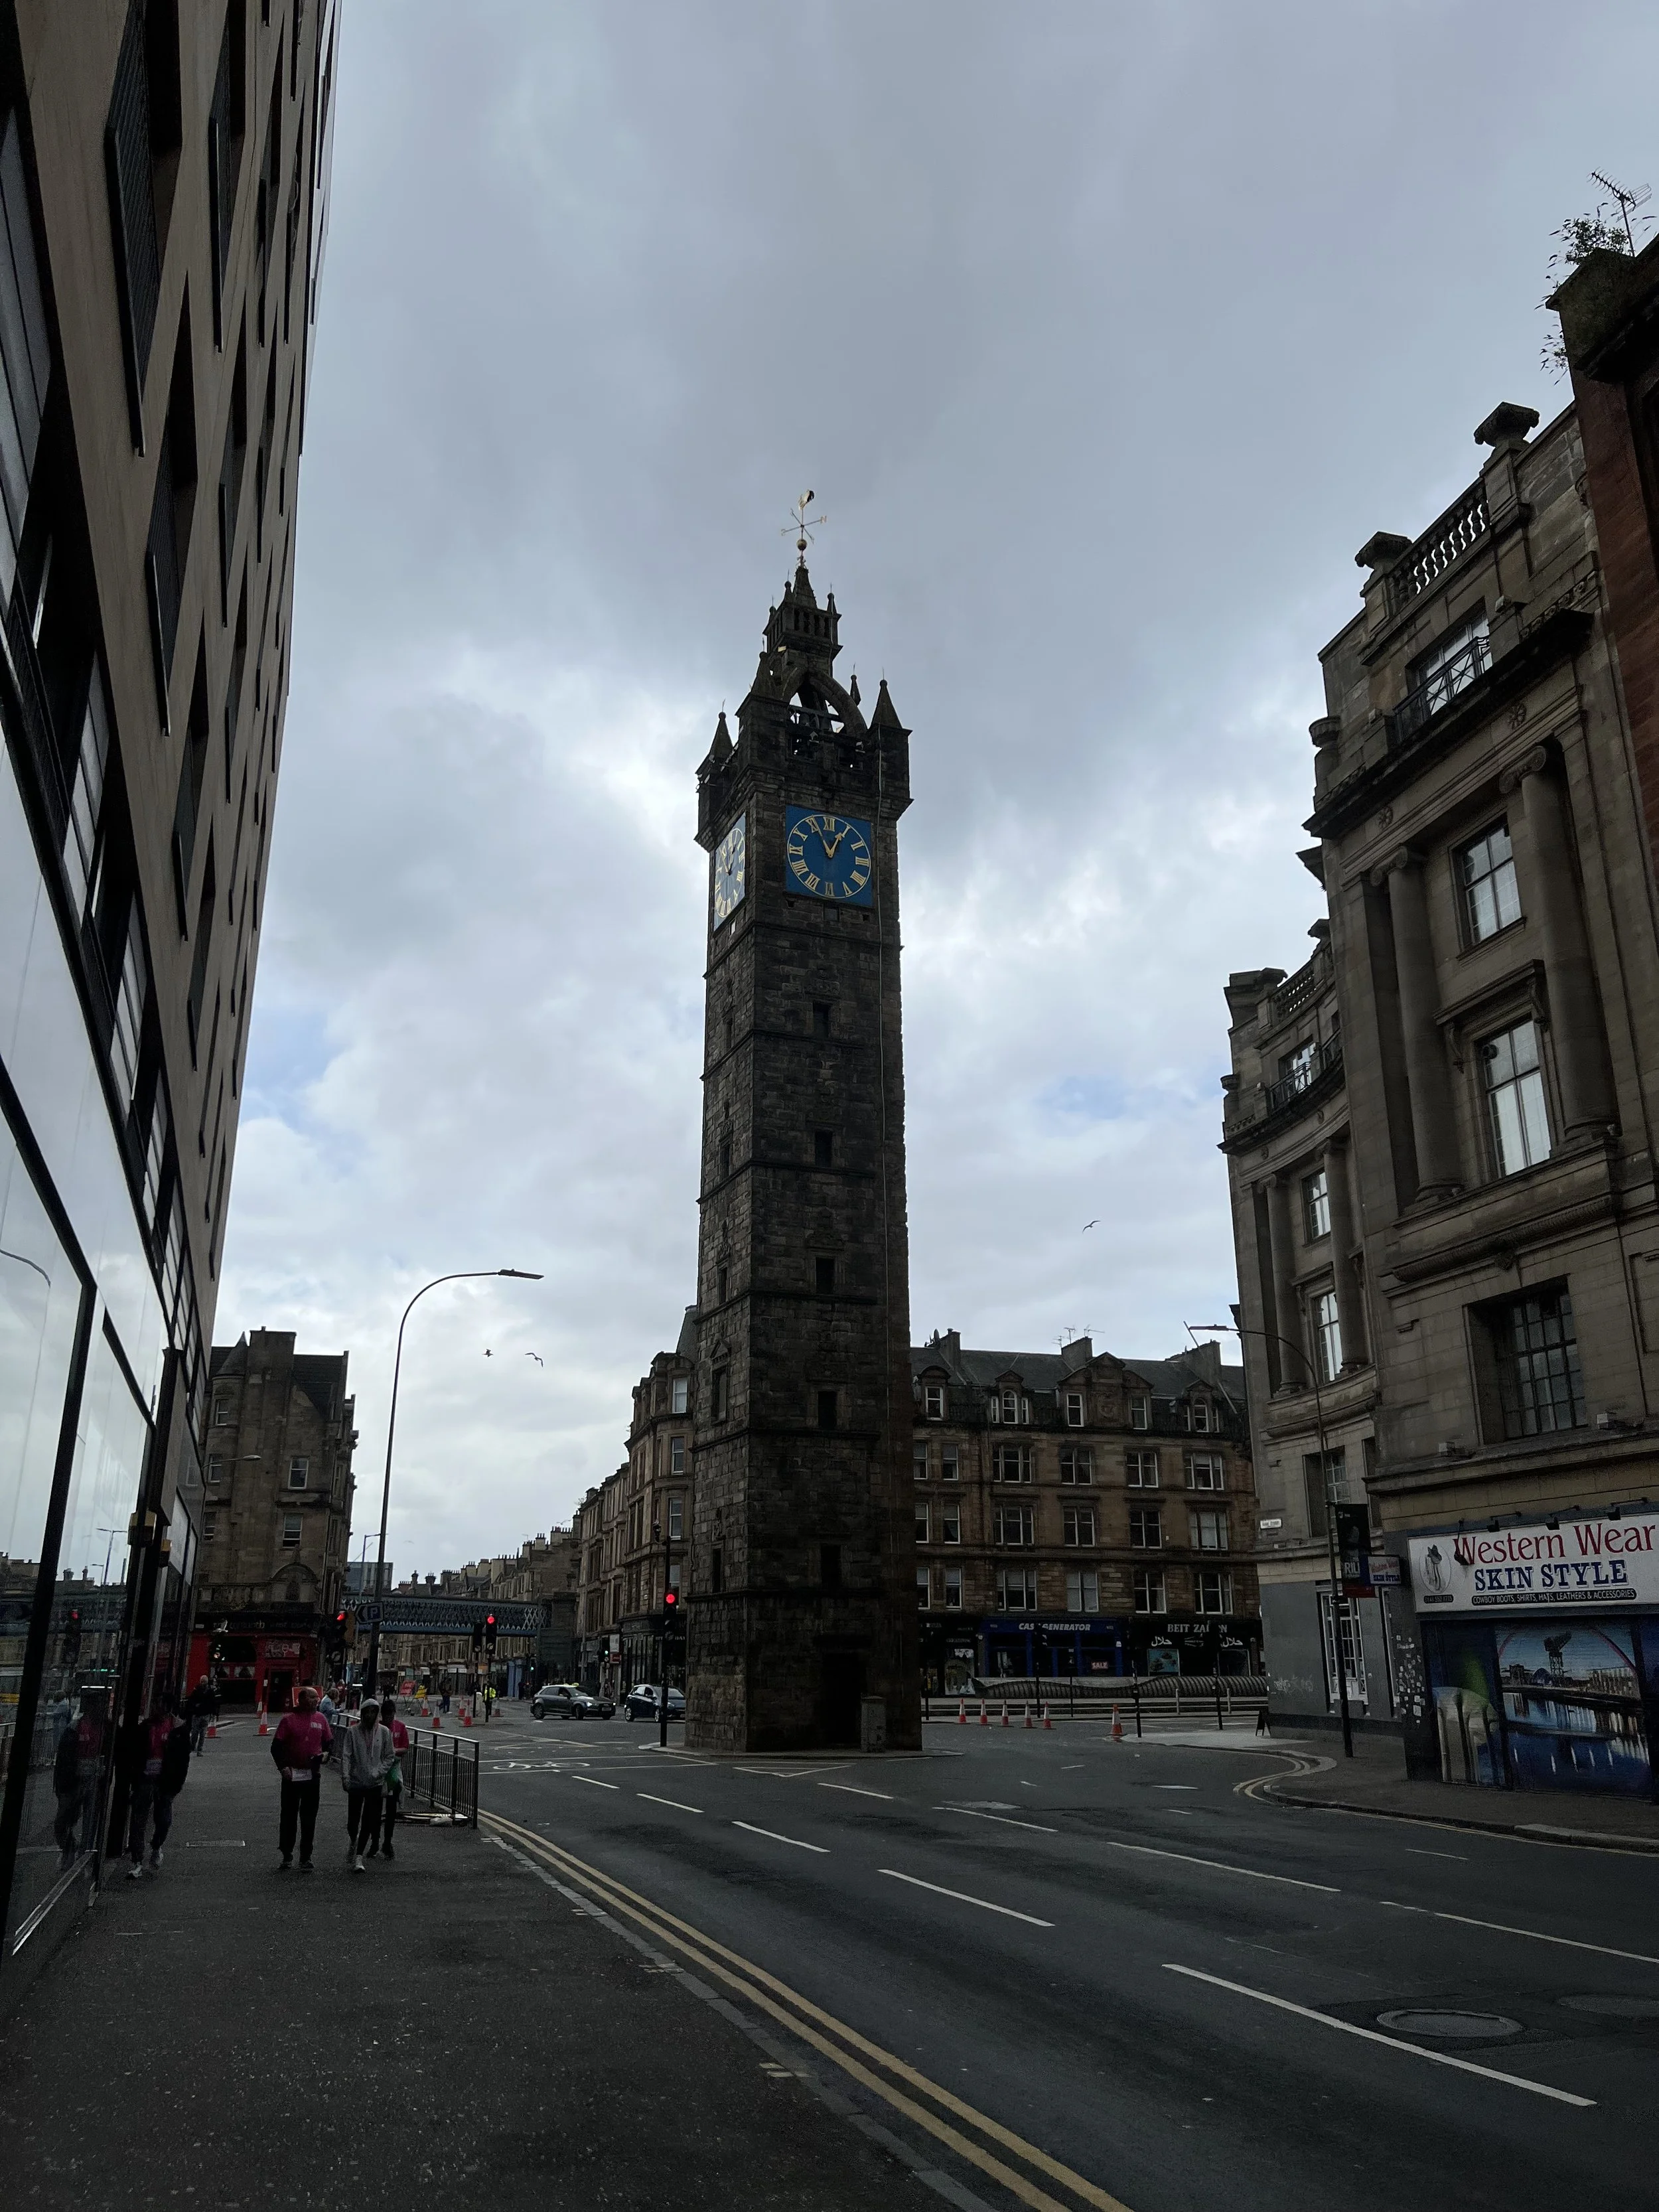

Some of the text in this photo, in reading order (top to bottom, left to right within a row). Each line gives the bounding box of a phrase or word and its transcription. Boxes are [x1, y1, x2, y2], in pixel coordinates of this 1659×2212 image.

[823, 817, 835, 832] XII
[793, 828, 808, 841] X
[850, 840, 865, 851] II
[855, 856, 869, 867] III
[804, 873, 820, 890] VII
[842, 881, 853, 895] V
[1453, 1523, 1656, 1565] Western Wear
[1475, 1560, 1627, 1591] SKIN STYLE
[1540, 1593, 1555, 1601] HATS,
[1593, 1589, 1634, 1599] ACCESSORIES
[1168, 1623, 1189, 1633] BEIT
